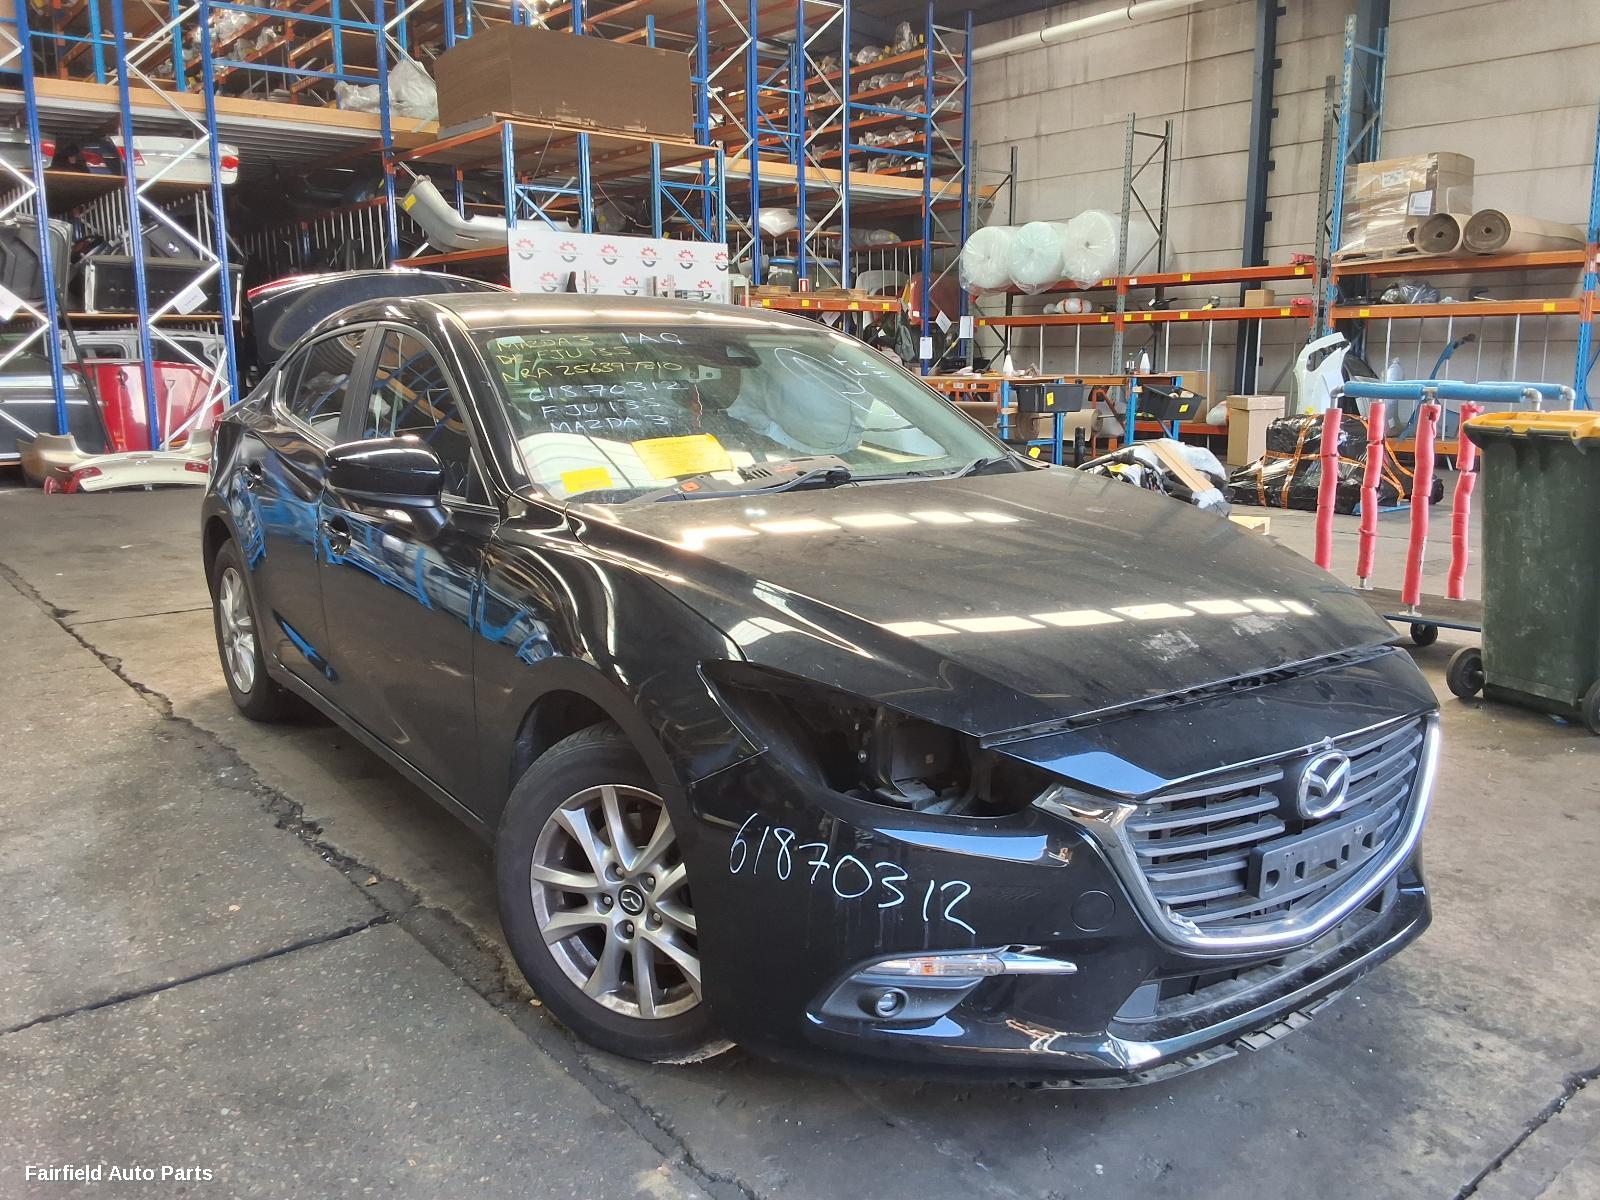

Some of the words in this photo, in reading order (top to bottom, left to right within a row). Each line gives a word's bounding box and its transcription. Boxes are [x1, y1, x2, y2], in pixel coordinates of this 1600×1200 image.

[529, 381, 689, 402] 61870312
[550, 416, 639, 434] MAZDA
[729, 812, 976, 935] 61870312
